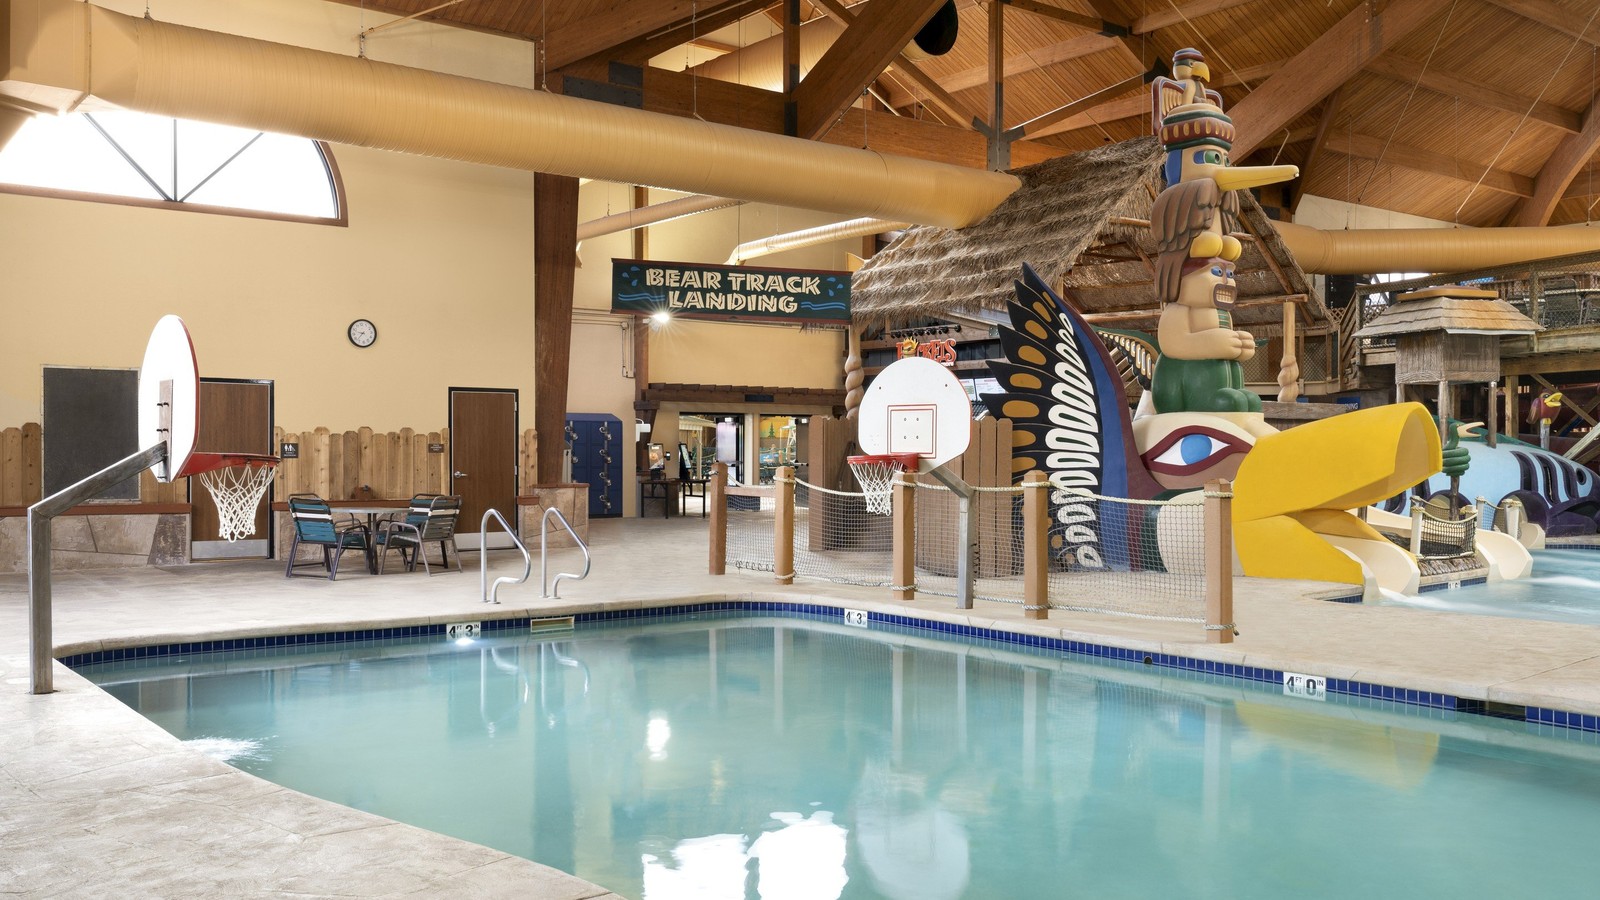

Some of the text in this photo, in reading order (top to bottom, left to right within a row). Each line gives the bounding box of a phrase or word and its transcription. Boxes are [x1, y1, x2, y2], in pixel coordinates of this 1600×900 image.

[645, 268, 821, 295] BEAR TRACK
[668, 290, 799, 313] LANDING
[1295, 676, 1303, 684] FT
[1316, 679, 1324, 687] IN
